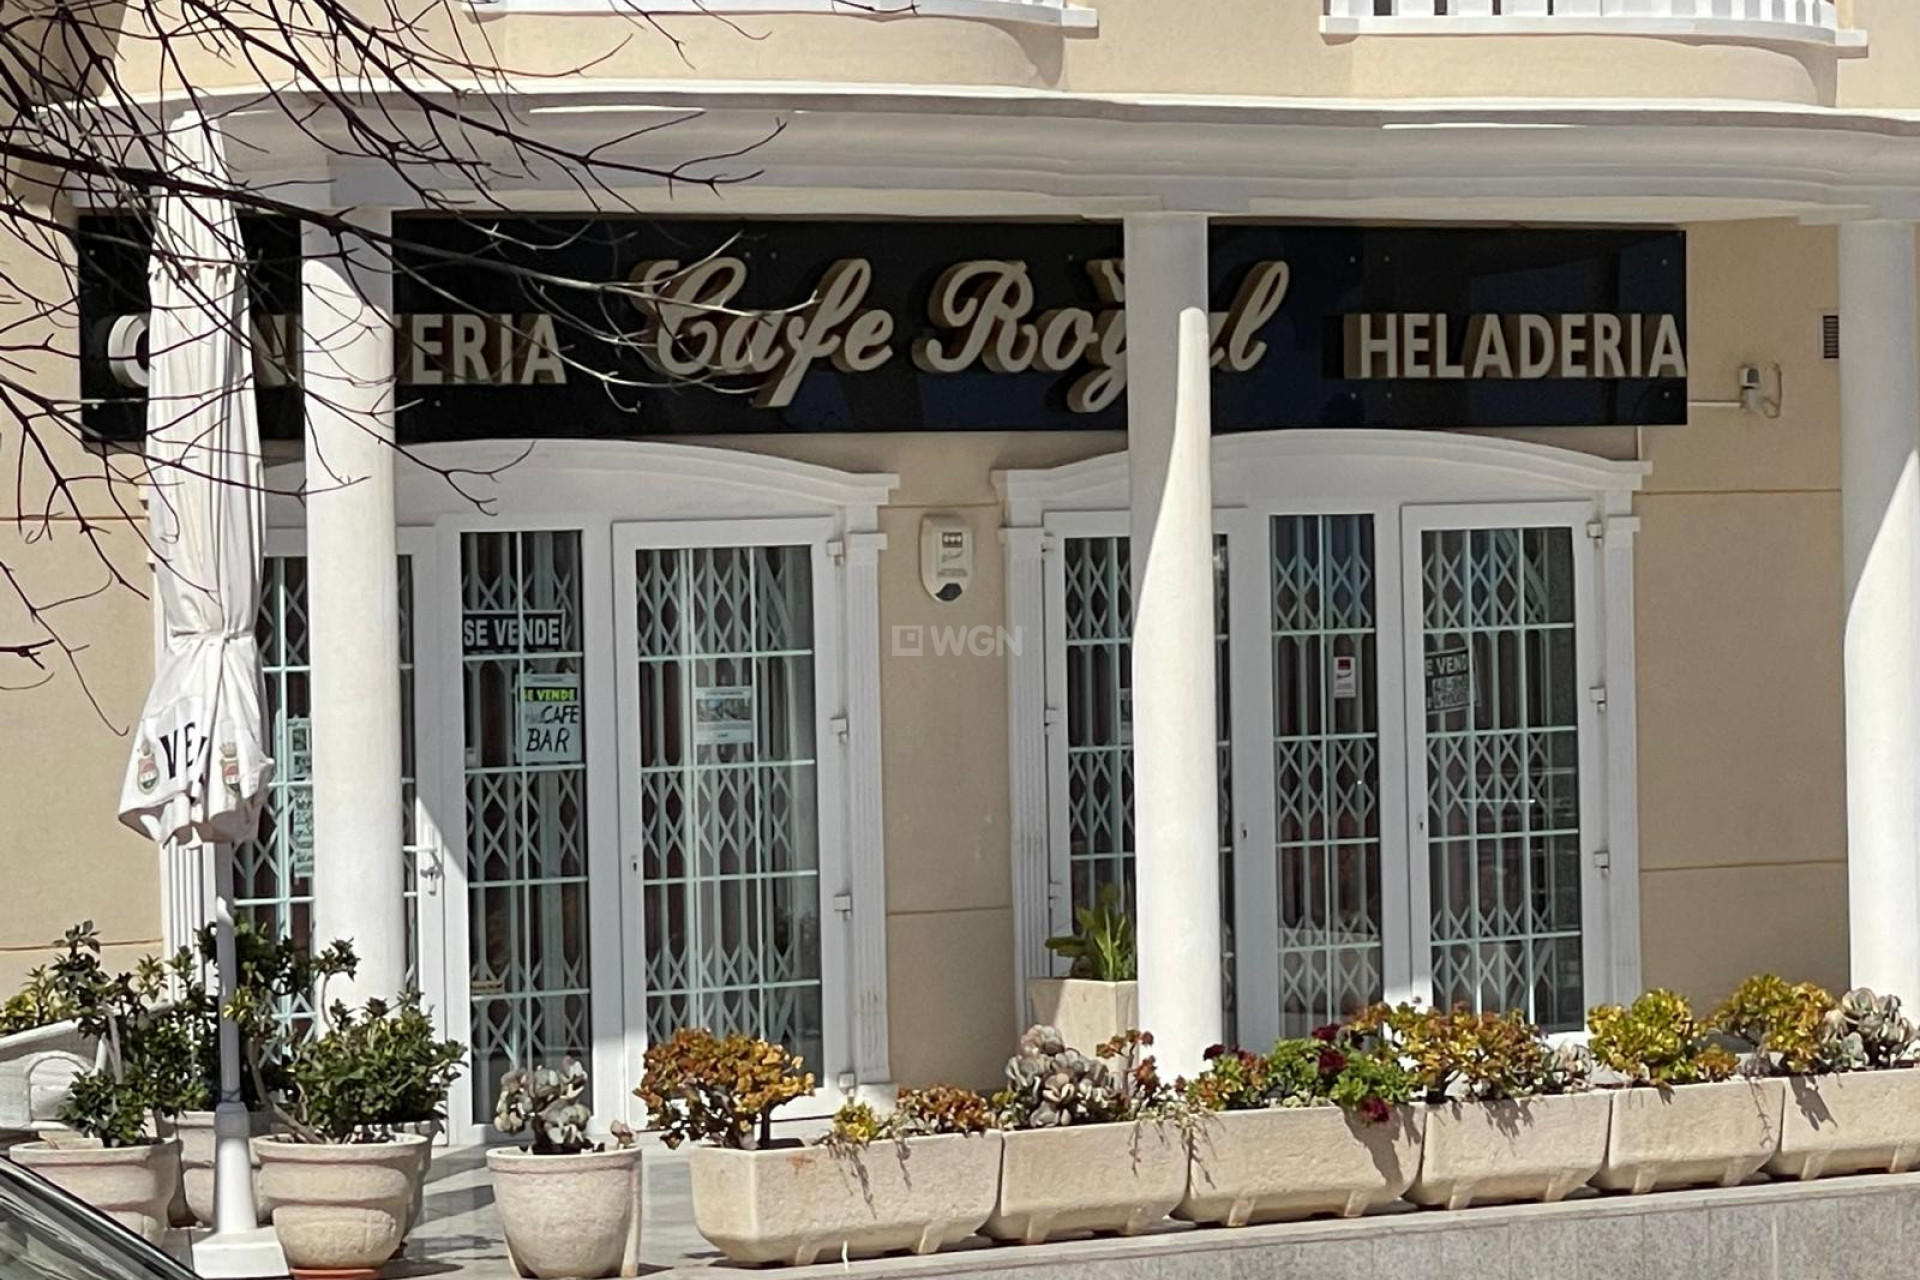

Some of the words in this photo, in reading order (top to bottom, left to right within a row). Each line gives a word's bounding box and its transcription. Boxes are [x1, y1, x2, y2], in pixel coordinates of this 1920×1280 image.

[628, 256, 894, 408] Cafe
[1344, 312, 1688, 380] HELADERIA
[463, 618, 488, 646] SE
[494, 618, 560, 646] VENDE
[541, 704, 580, 724] CAFE
[526, 726, 571, 753] BAR
